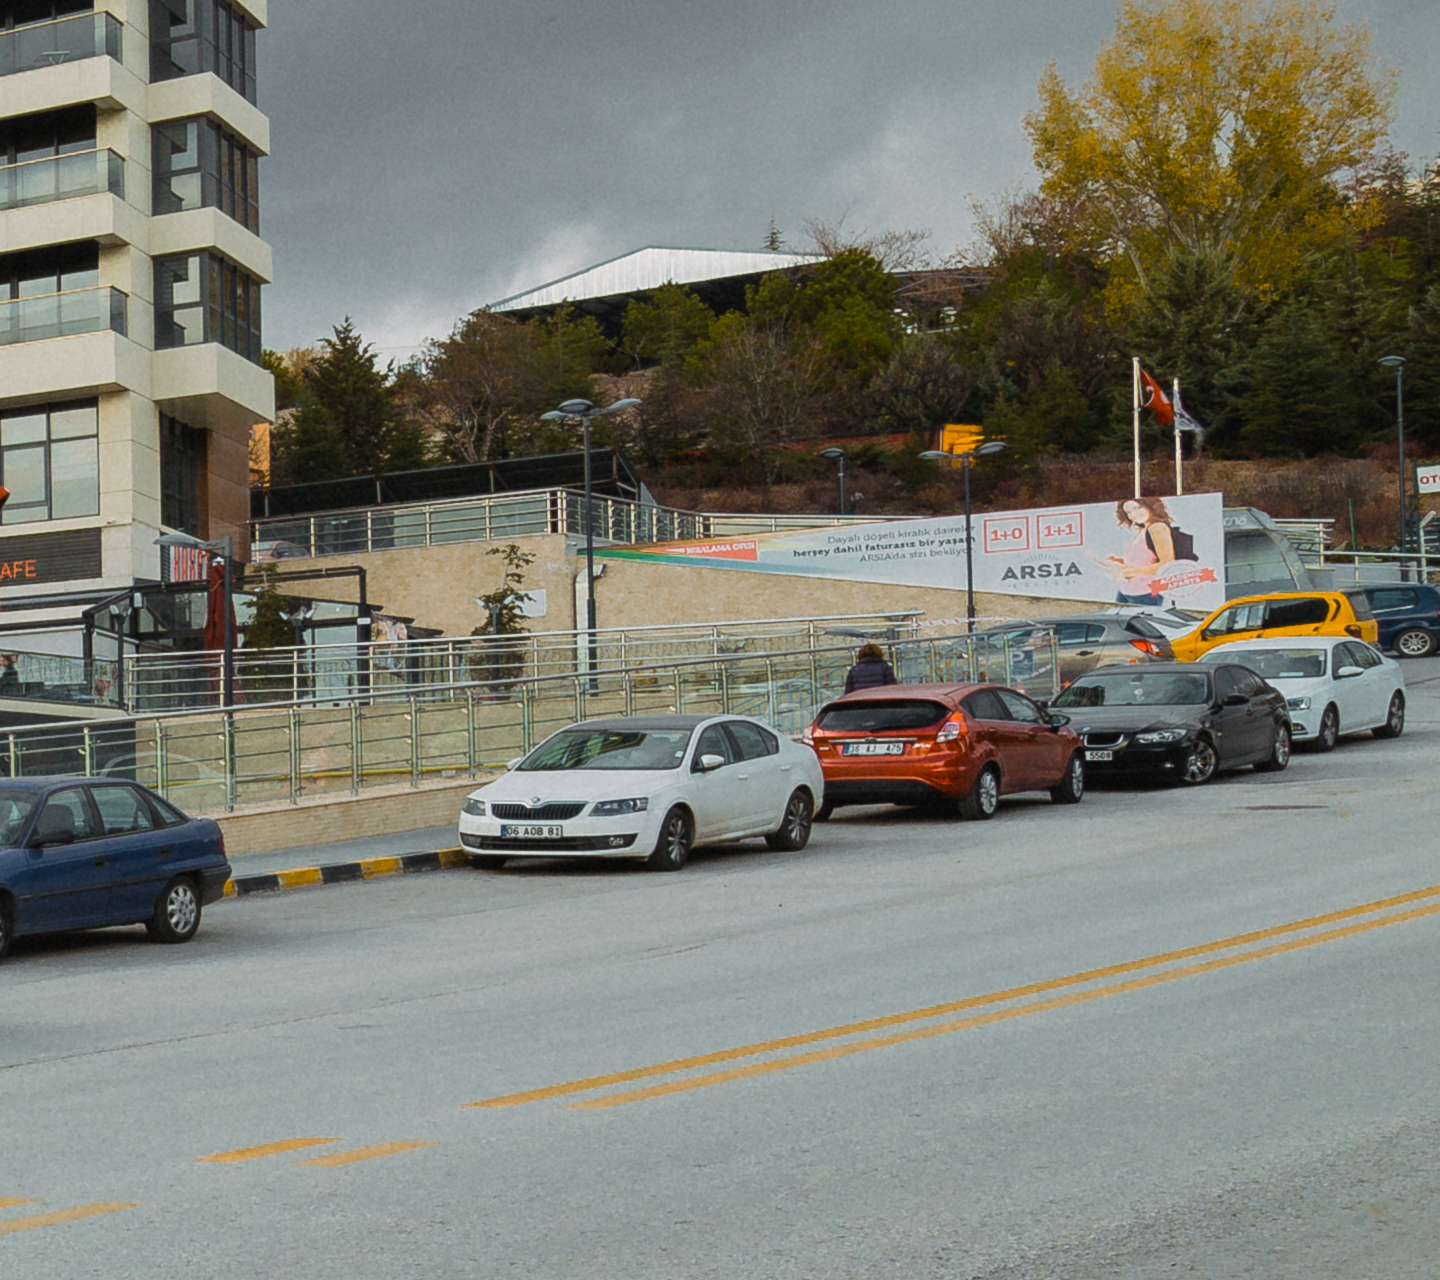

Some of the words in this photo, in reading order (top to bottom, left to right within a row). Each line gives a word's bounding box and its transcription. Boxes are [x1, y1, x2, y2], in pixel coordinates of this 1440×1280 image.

[990, 527, 1023, 542] 1+0
[1043, 523, 1077, 538] 1+1
[833, 544, 863, 555] dahil
[918, 538, 935, 548] bir
[1001, 561, 1083, 581] ARSIA
